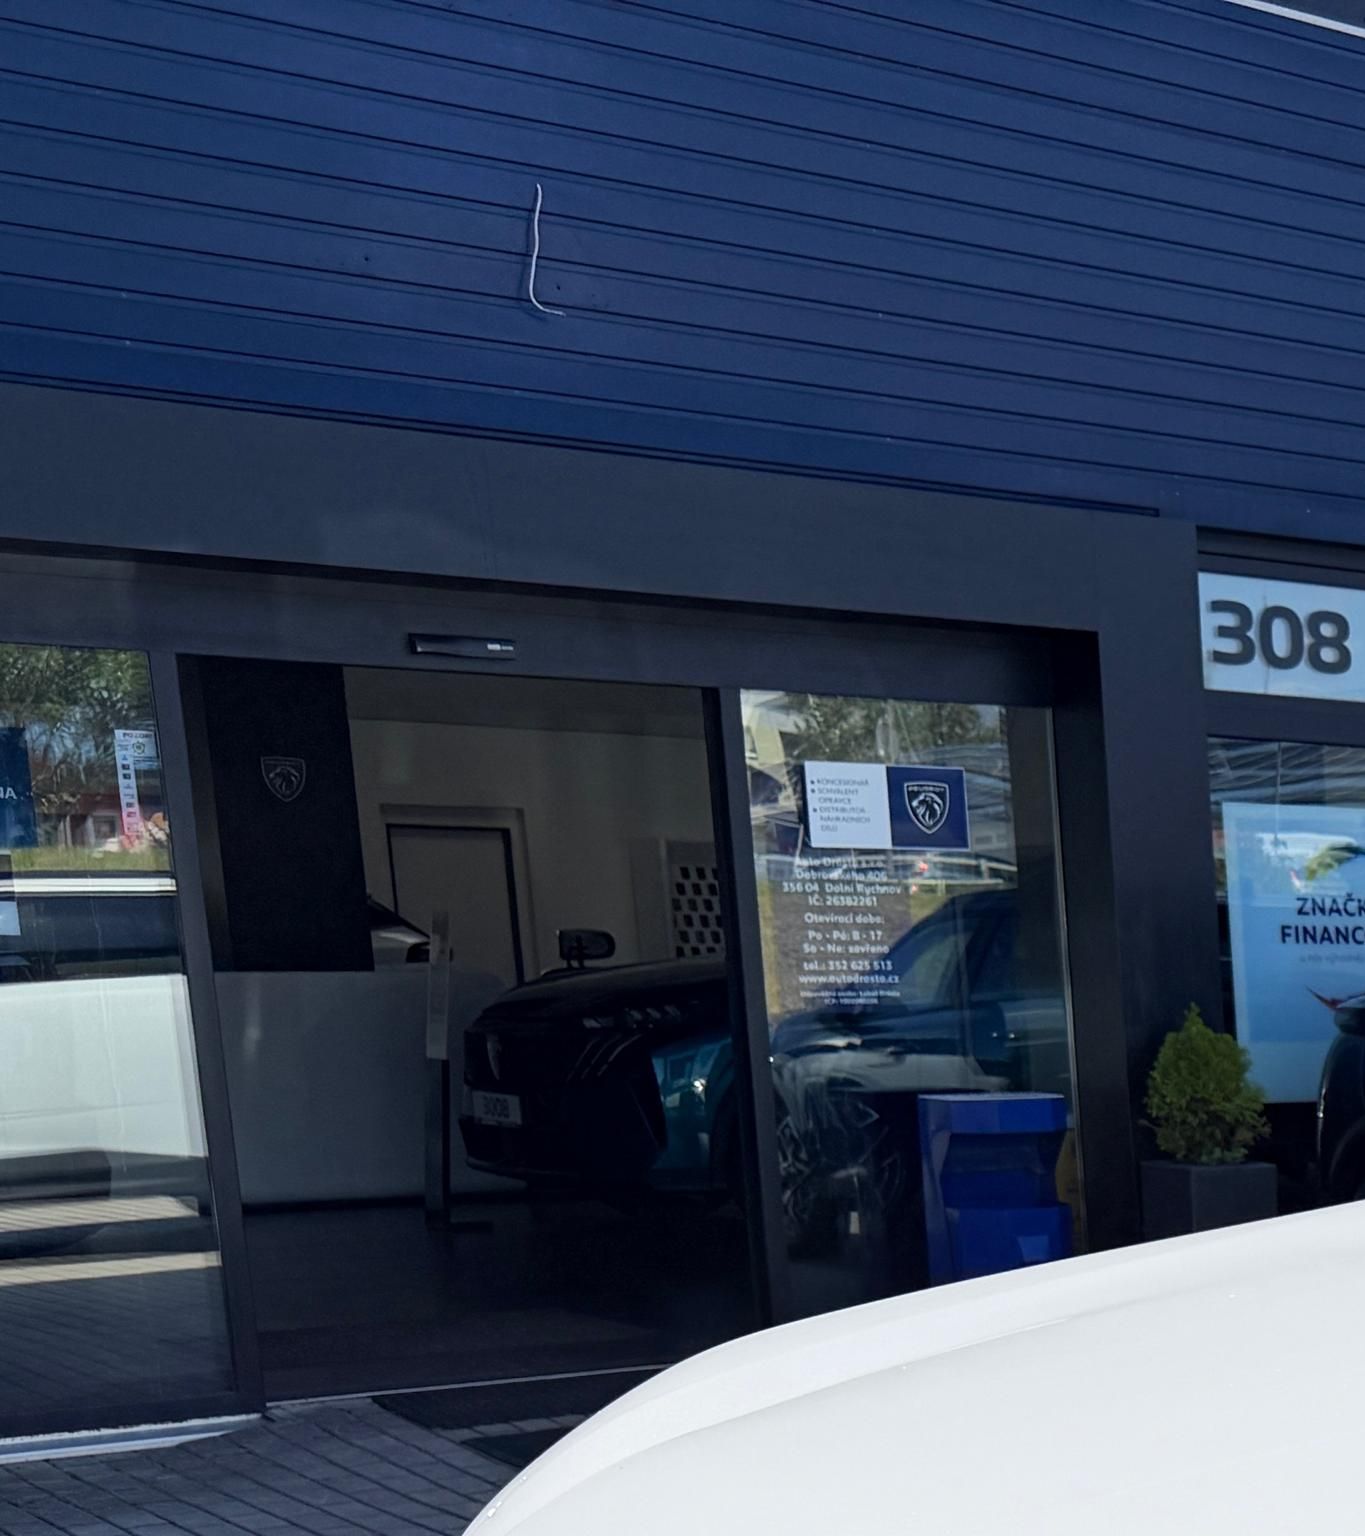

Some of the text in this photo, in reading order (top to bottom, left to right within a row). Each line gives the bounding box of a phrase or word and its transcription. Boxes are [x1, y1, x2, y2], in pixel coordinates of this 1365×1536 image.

[1209, 600, 1352, 674] 308
[804, 911, 853, 925] Otevírací
[808, 930, 823, 941] Po
[869, 930, 883, 941] 17
